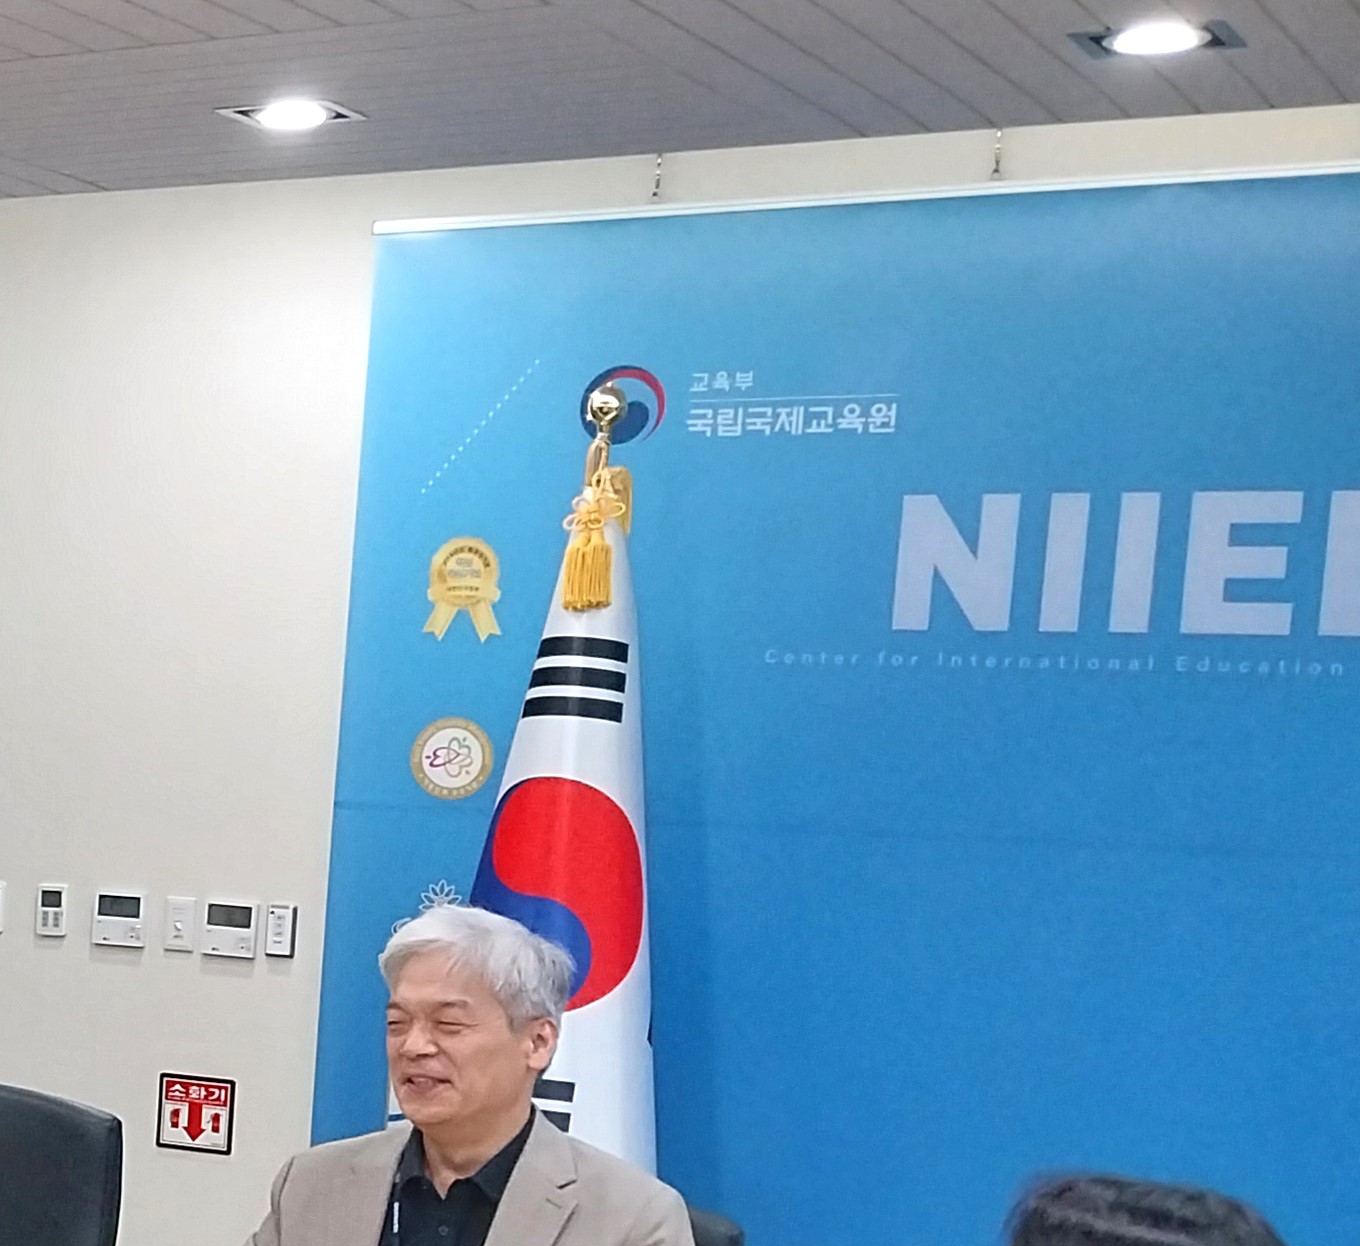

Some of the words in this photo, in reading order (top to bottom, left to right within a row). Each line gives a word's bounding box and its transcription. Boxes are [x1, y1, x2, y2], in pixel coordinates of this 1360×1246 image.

[689, 370, 754, 392] 교육부
[686, 402, 898, 437] 국립국제교육원
[891, 490, 1360, 637] NIIE
[763, 648, 861, 667] Center
[878, 649, 921, 668] for
[936, 651, 1156, 673] International
[1175, 654, 1346, 677] Education
[167, 1084, 226, 1102] 소화기
